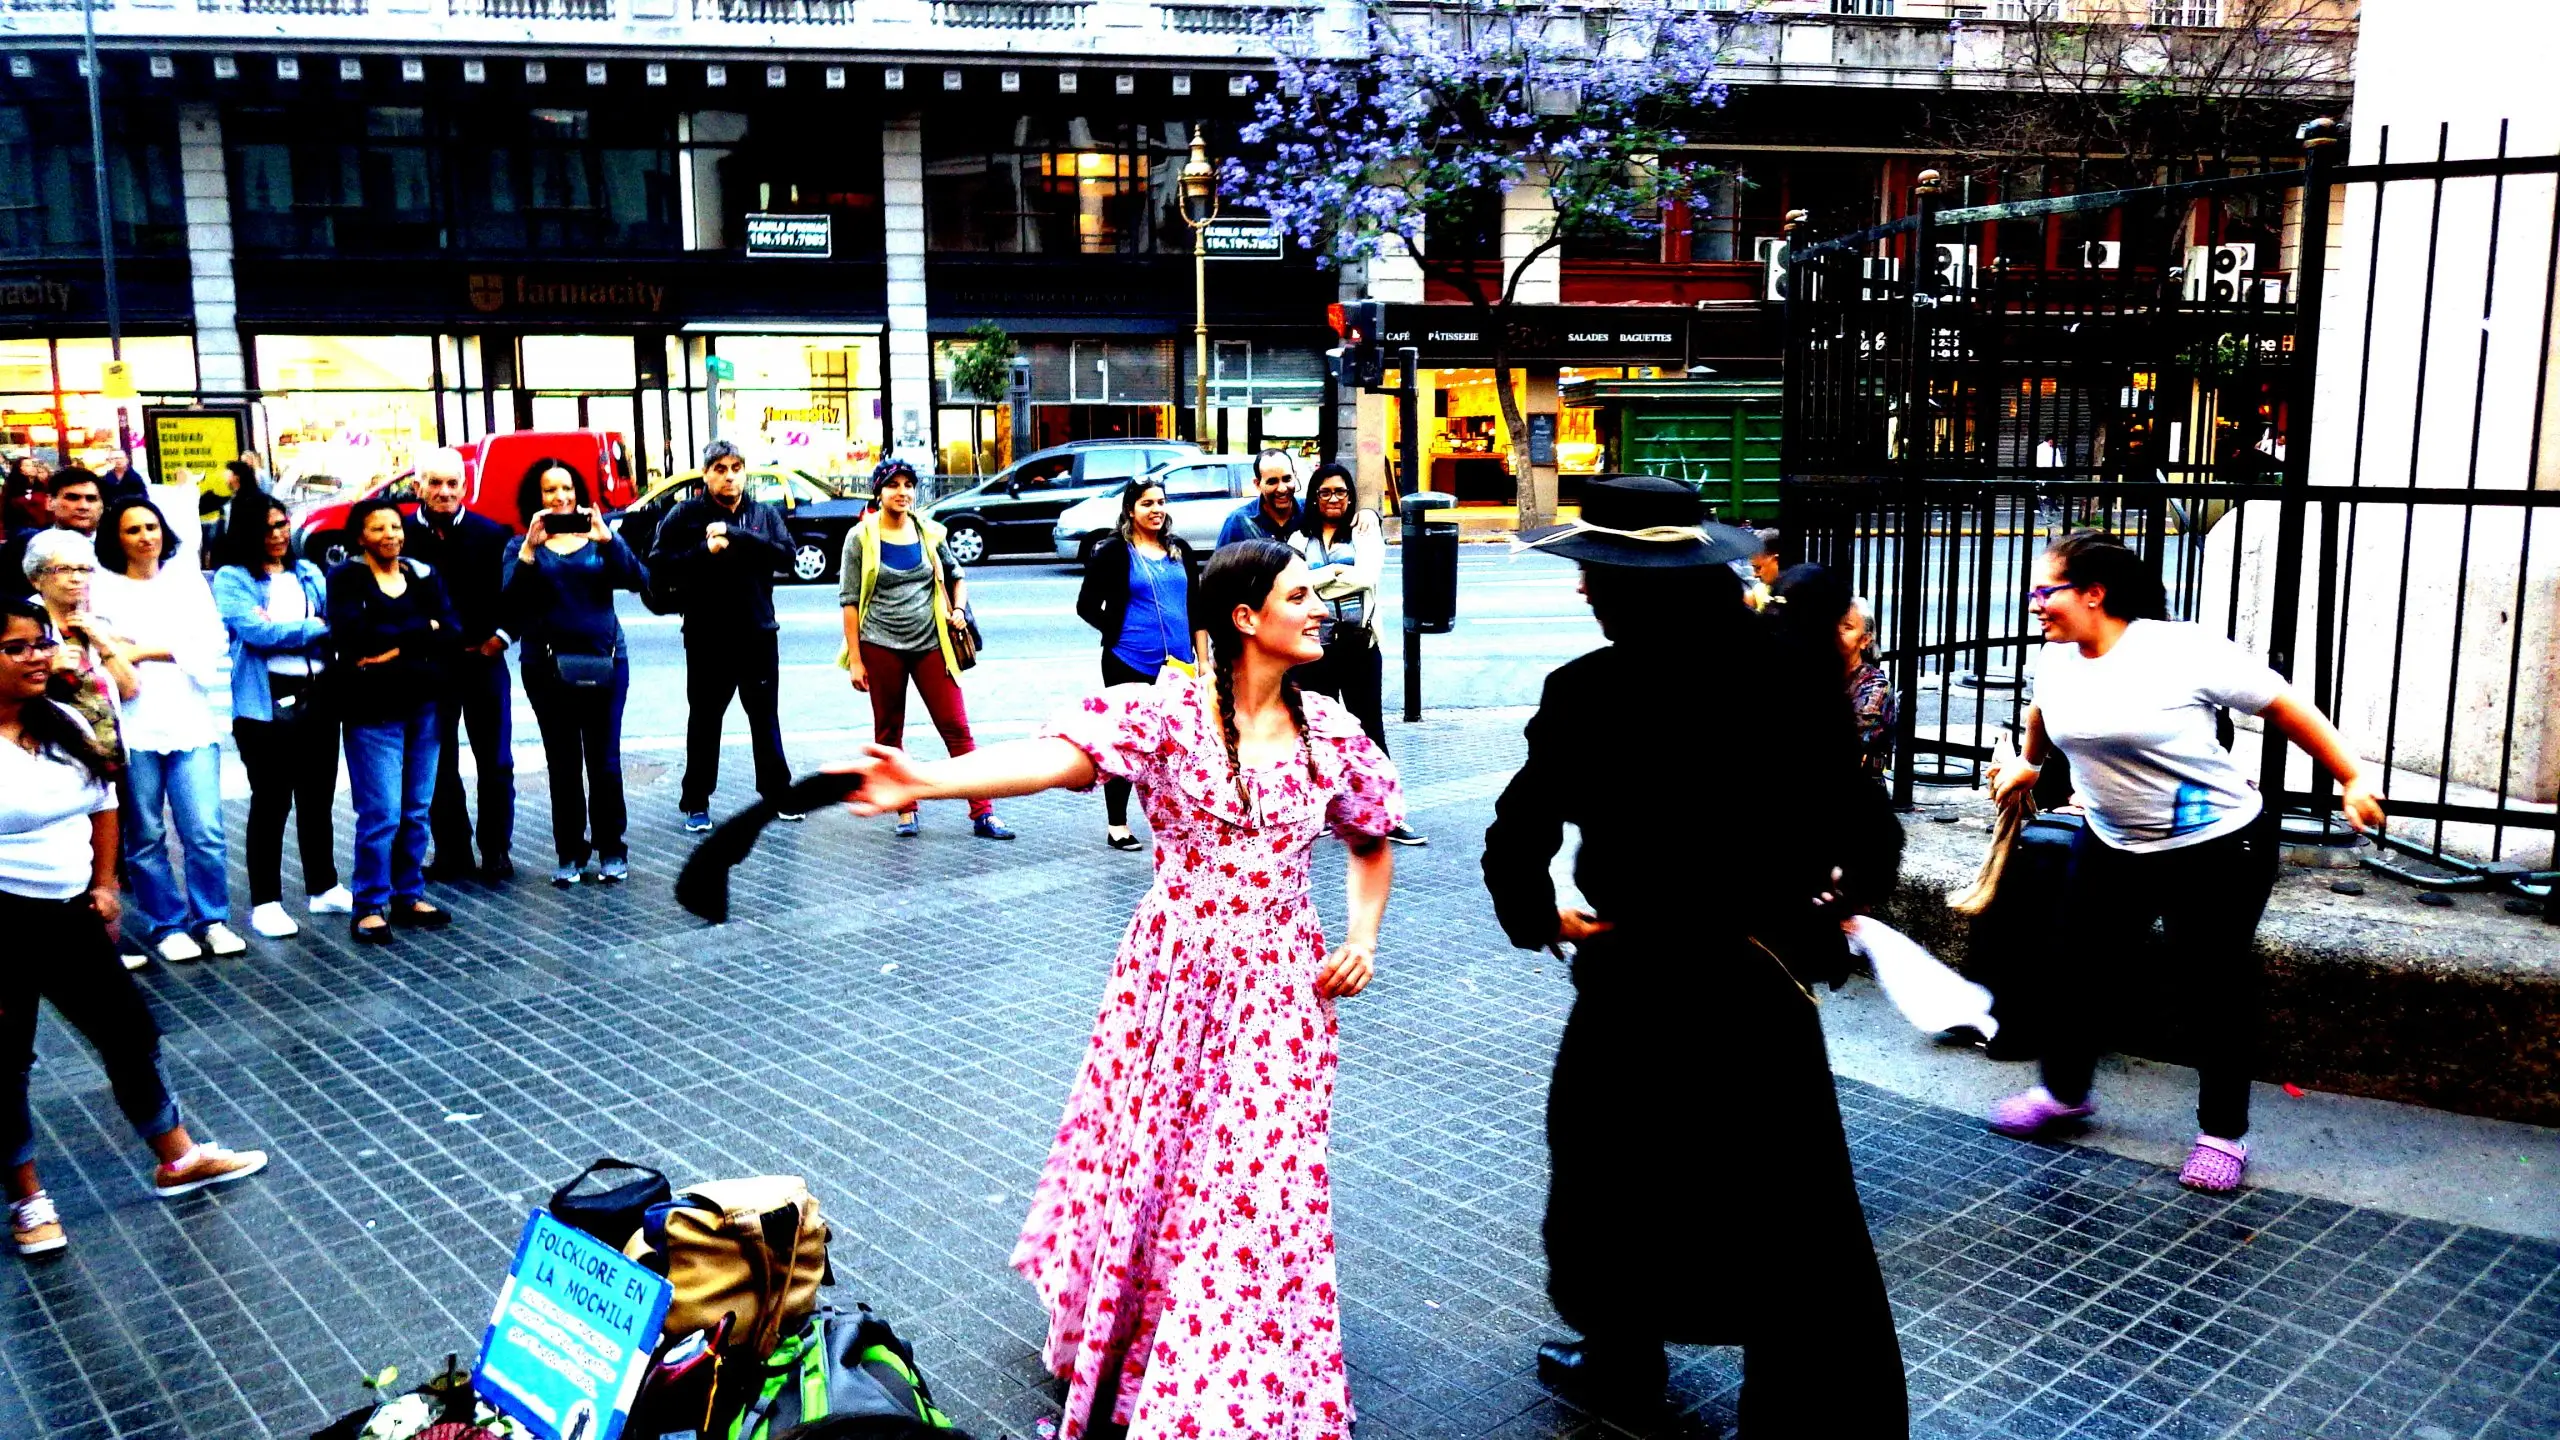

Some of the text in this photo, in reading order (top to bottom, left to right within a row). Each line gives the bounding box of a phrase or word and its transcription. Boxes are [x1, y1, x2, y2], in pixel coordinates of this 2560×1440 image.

[516, 272, 665, 312] farmacity
[1386, 331, 1411, 341] CAFÉ
[1567, 333, 1673, 342] SALADES BAGUETTES
[161, 432, 204, 443] CIUDAD
[536, 1226, 648, 1305] FOLCKLORE EN
[536, 1260, 554, 1288] LA
[563, 1279, 634, 1337] MOCHILA
